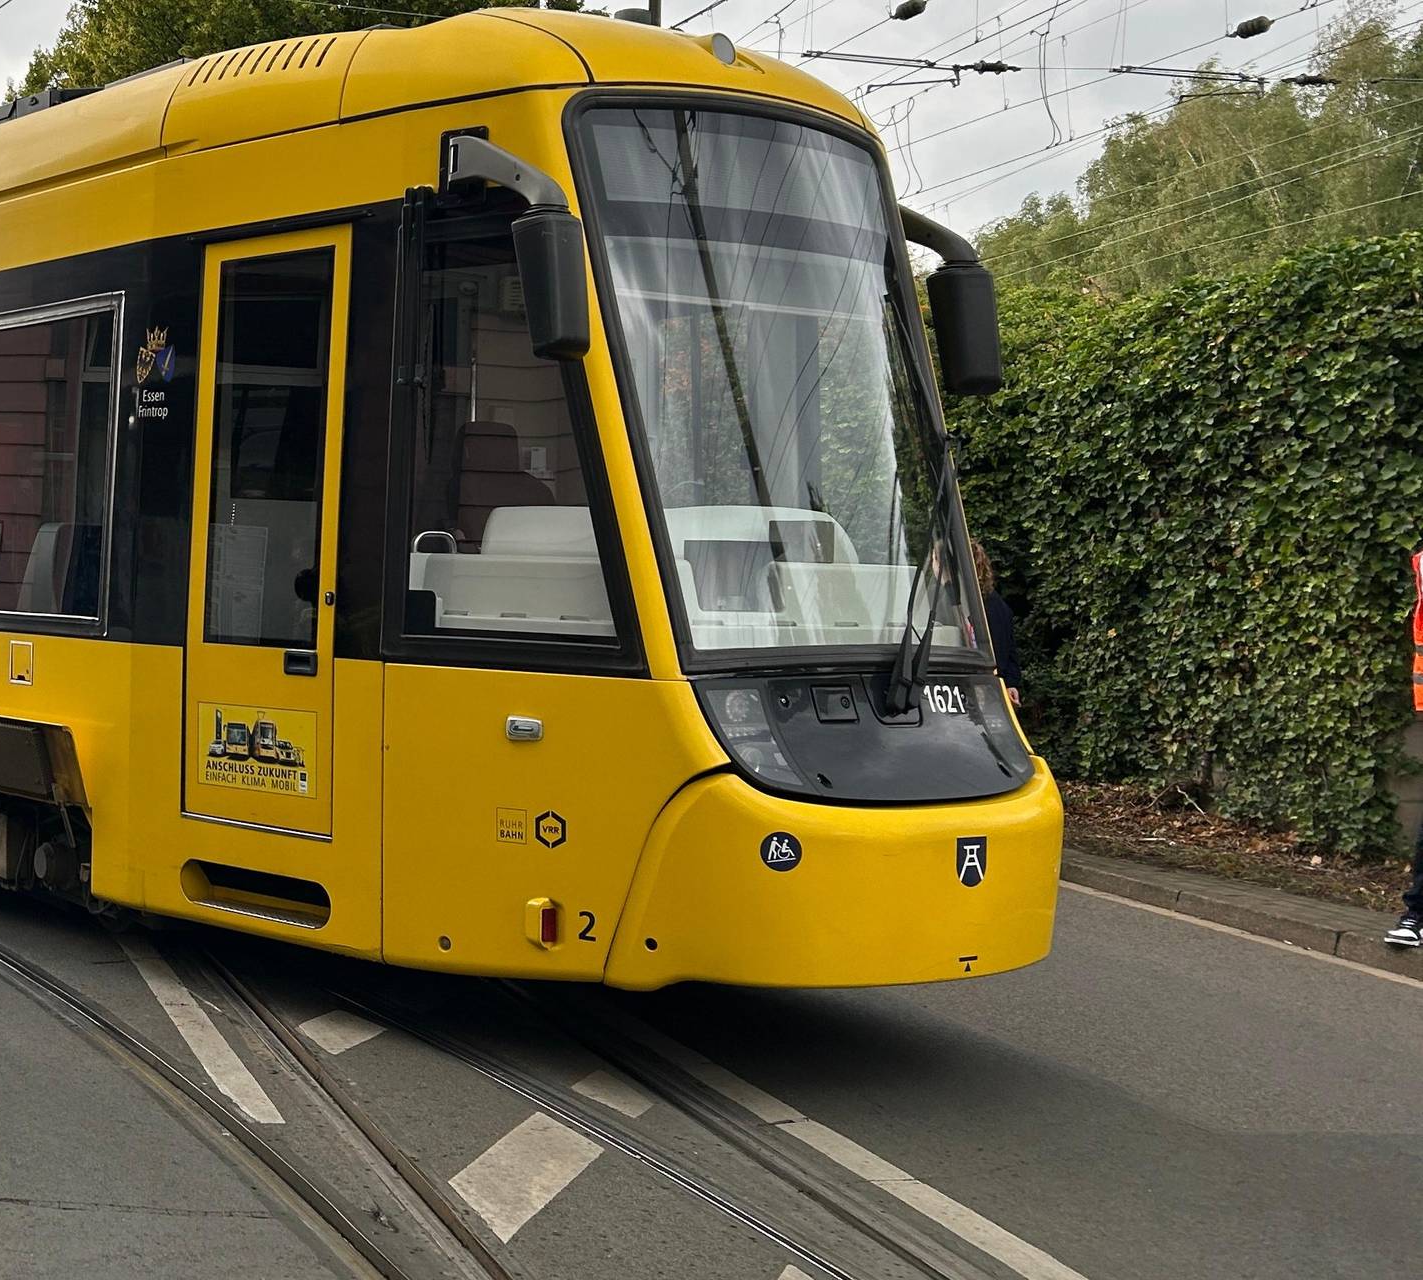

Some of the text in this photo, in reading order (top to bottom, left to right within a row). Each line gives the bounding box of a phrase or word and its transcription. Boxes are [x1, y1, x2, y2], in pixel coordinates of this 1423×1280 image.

[142, 389, 165, 402] Essen
[138, 405, 169, 420] Frintrop
[923, 684, 966, 713] 1621
[205, 760, 298, 780] ANSCHLUSS ZUKUNFT
[205, 770, 237, 784] EINFACH
[241, 774, 267, 788] KLIMA
[271, 778, 298, 792] MOBIL
[499, 818, 523, 829] RUHR
[542, 825, 560, 835] VRR
[499, 830, 524, 840] BAHN
[577, 910, 597, 942] 2
